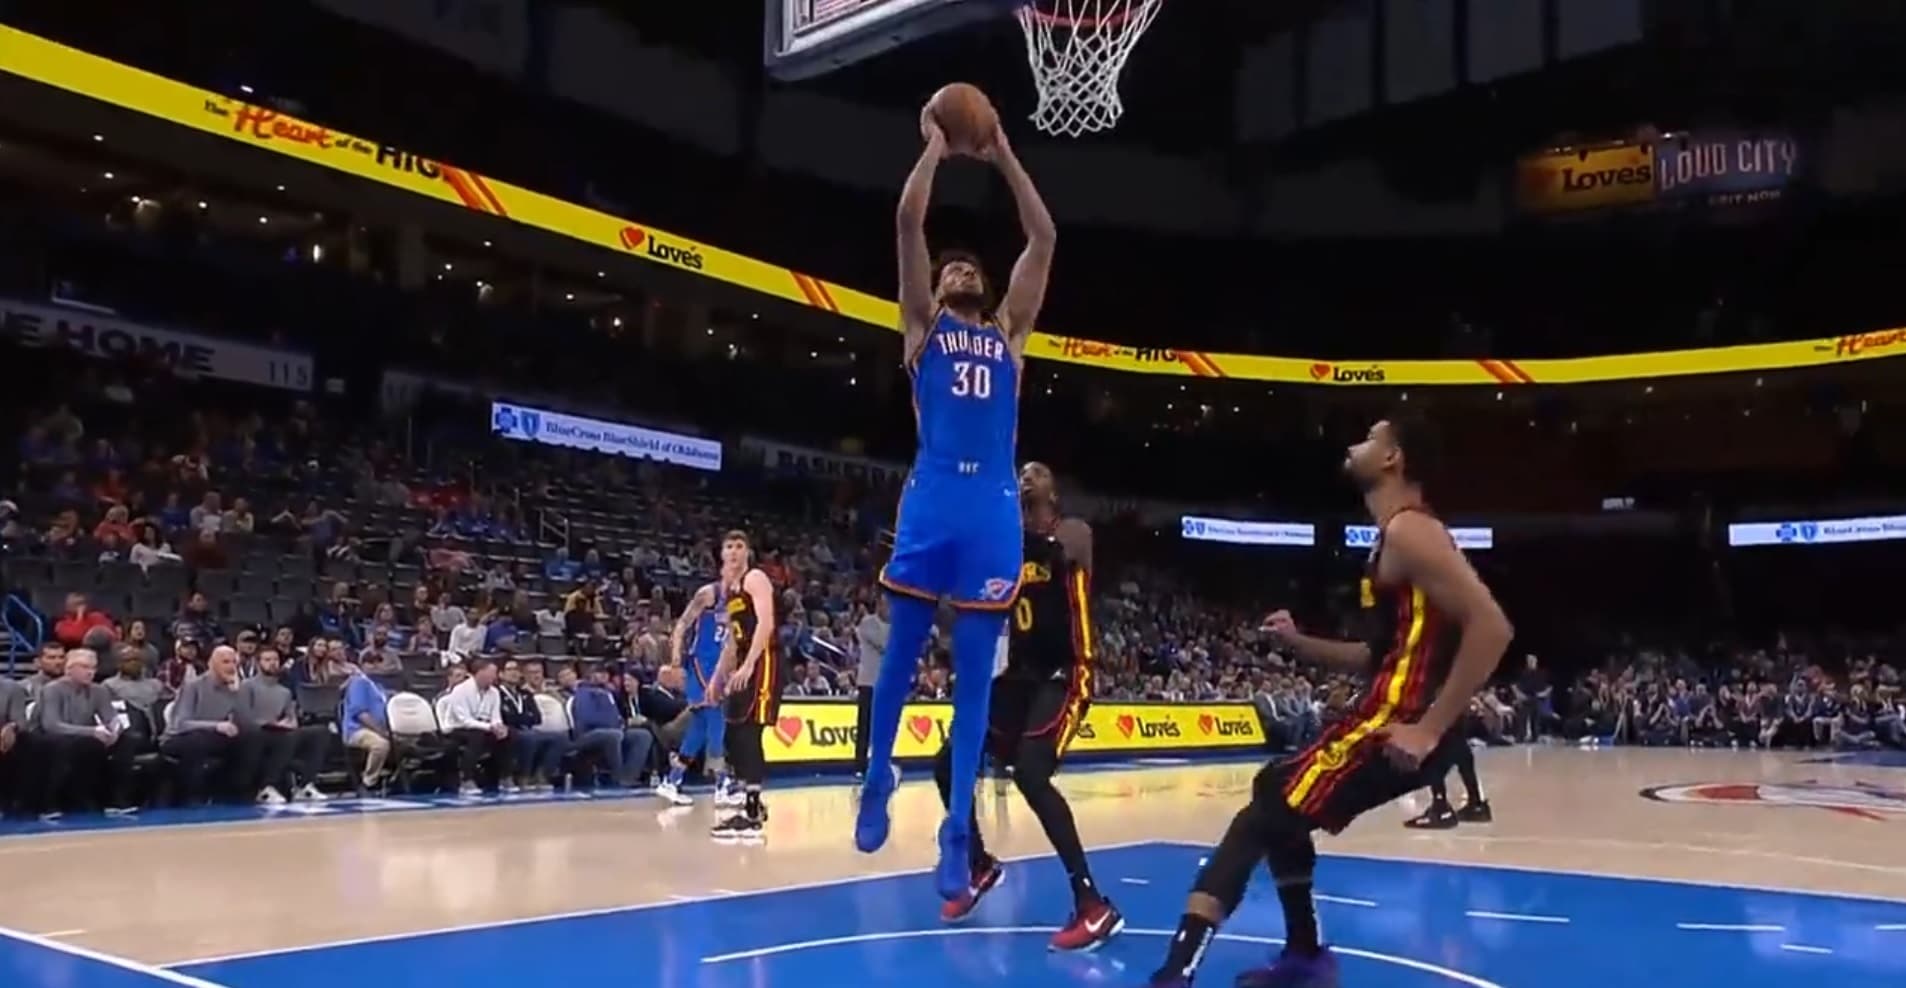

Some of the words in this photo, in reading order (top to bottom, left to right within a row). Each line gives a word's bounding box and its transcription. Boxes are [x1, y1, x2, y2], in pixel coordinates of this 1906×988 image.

[233, 105, 334, 149] Heart
[375, 145, 450, 182] HIG
[1660, 145, 1728, 191] LOUD
[1737, 138, 1797, 176] CITY
[57, 320, 215, 373] HOME
[1135, 347, 1183, 363] HIG
[952, 362, 991, 398] 30
[806, 719, 858, 747] Love
